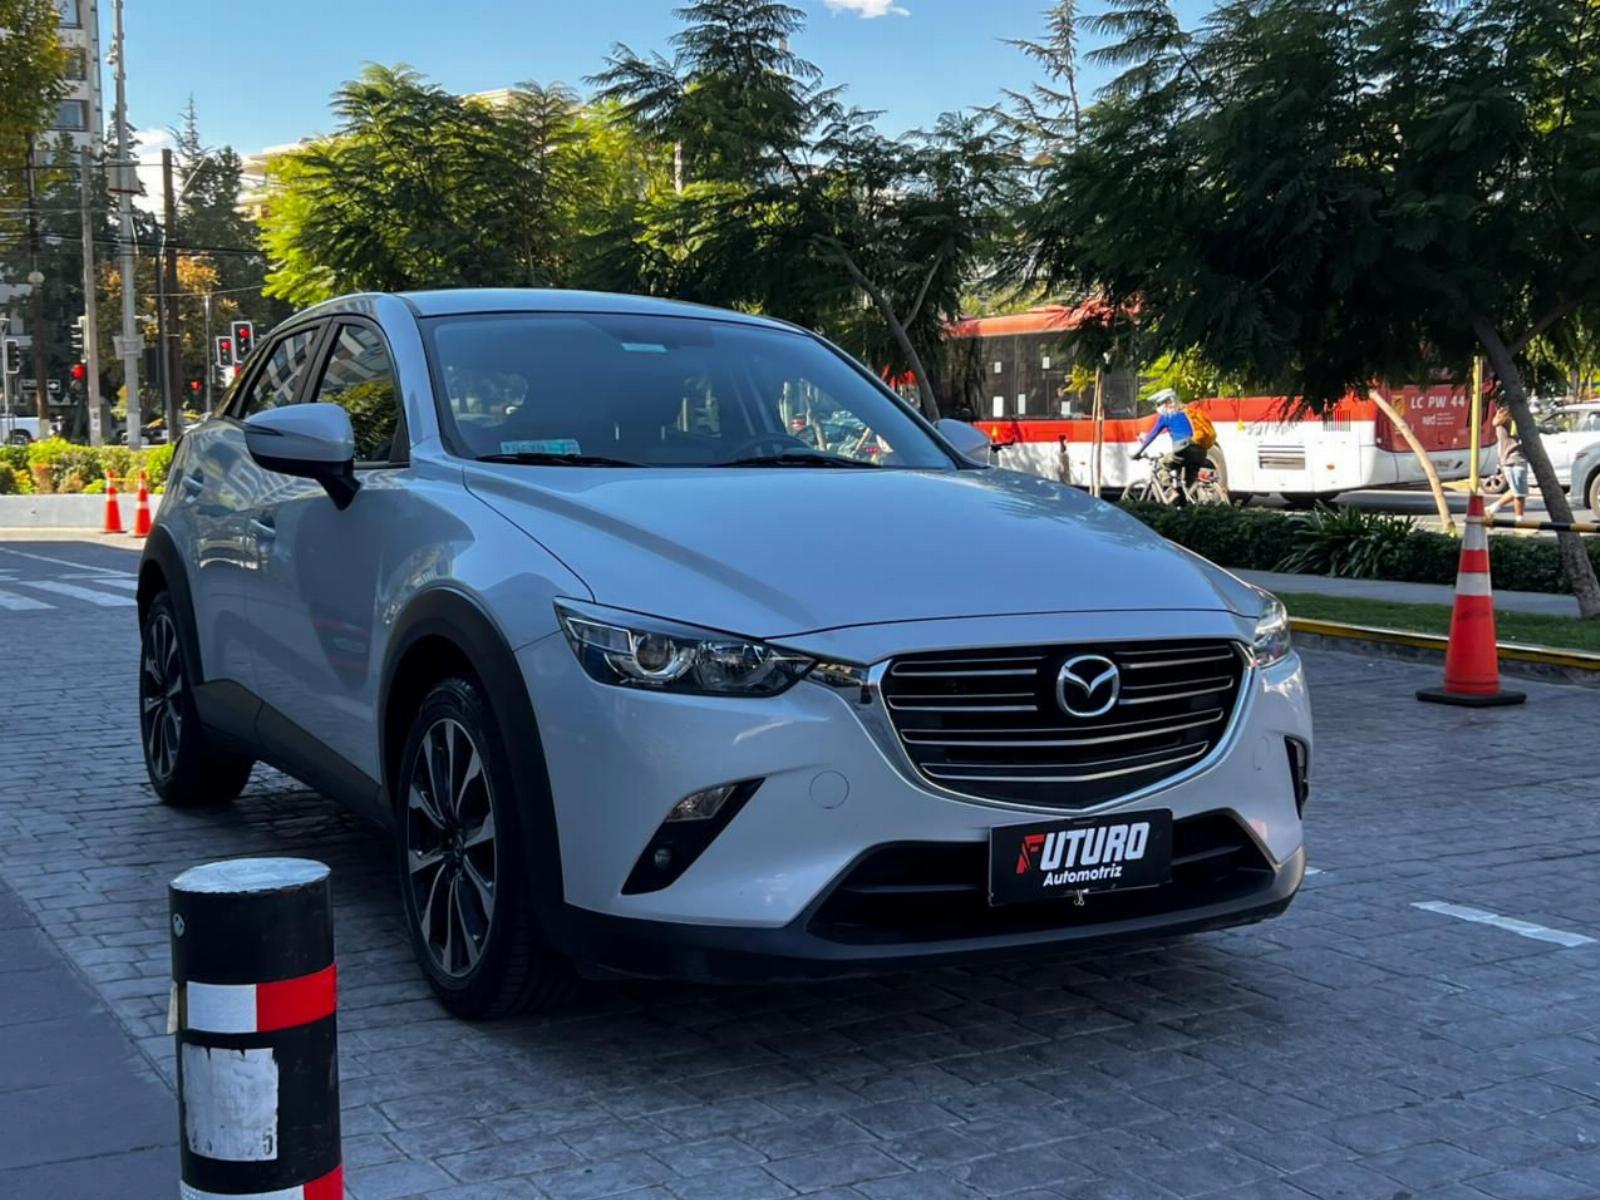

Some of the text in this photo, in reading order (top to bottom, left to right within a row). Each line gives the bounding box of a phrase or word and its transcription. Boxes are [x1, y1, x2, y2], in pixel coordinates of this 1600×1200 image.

[1411, 395, 1465, 409] LC PW 44
[1016, 822, 1150, 874] FUTURO
[1043, 864, 1122, 887] Automotriz
